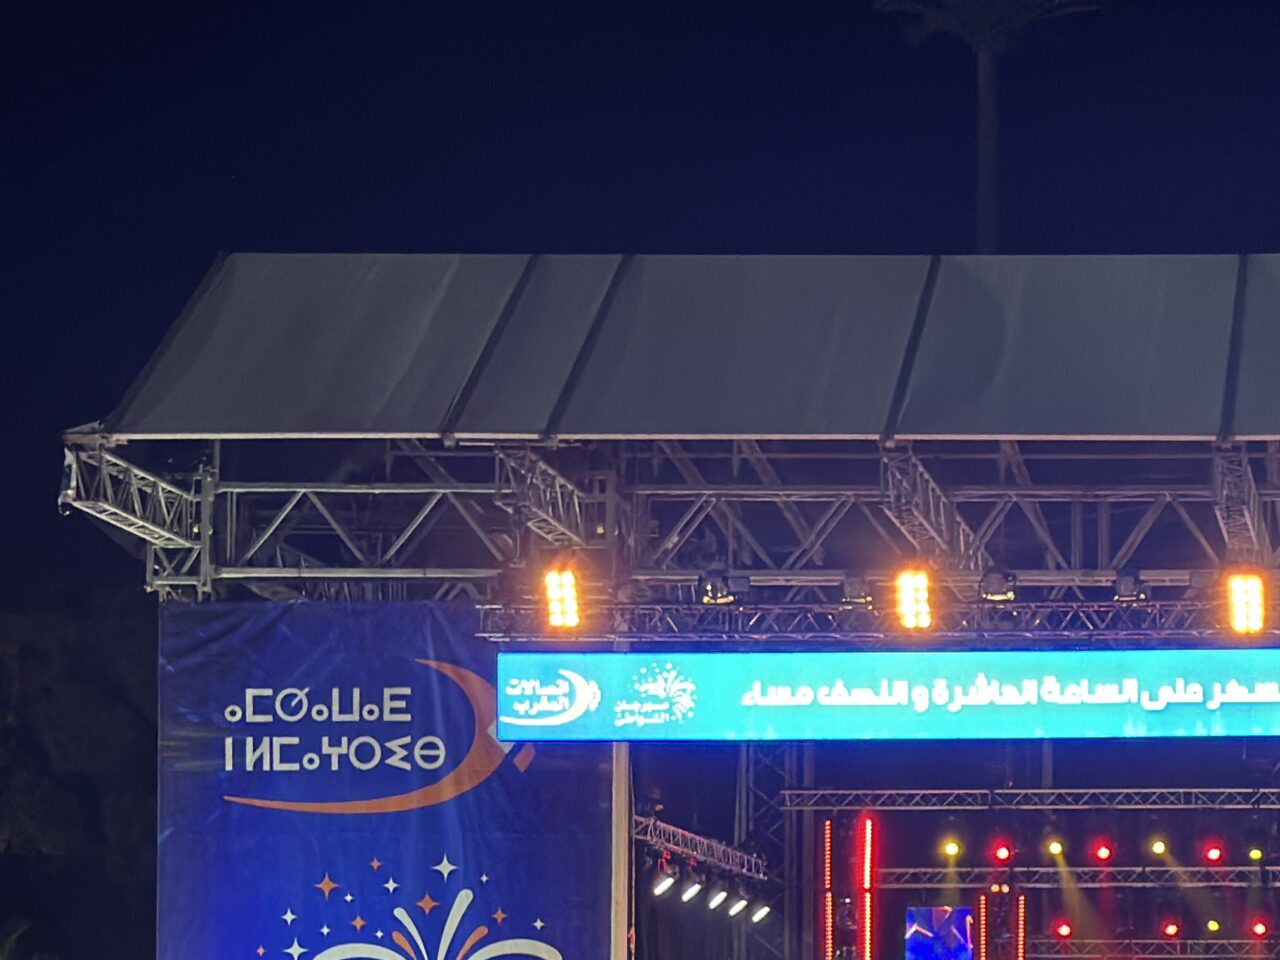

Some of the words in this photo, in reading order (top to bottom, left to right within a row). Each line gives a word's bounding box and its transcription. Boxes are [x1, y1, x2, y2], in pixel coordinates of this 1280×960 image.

[817, 680, 908, 704] النصف
[912, 686, 929, 711] و
[932, 673, 1037, 711] العاشرة
[1040, 677, 1137, 704] الساعة
[1142, 679, 1202, 709] على
